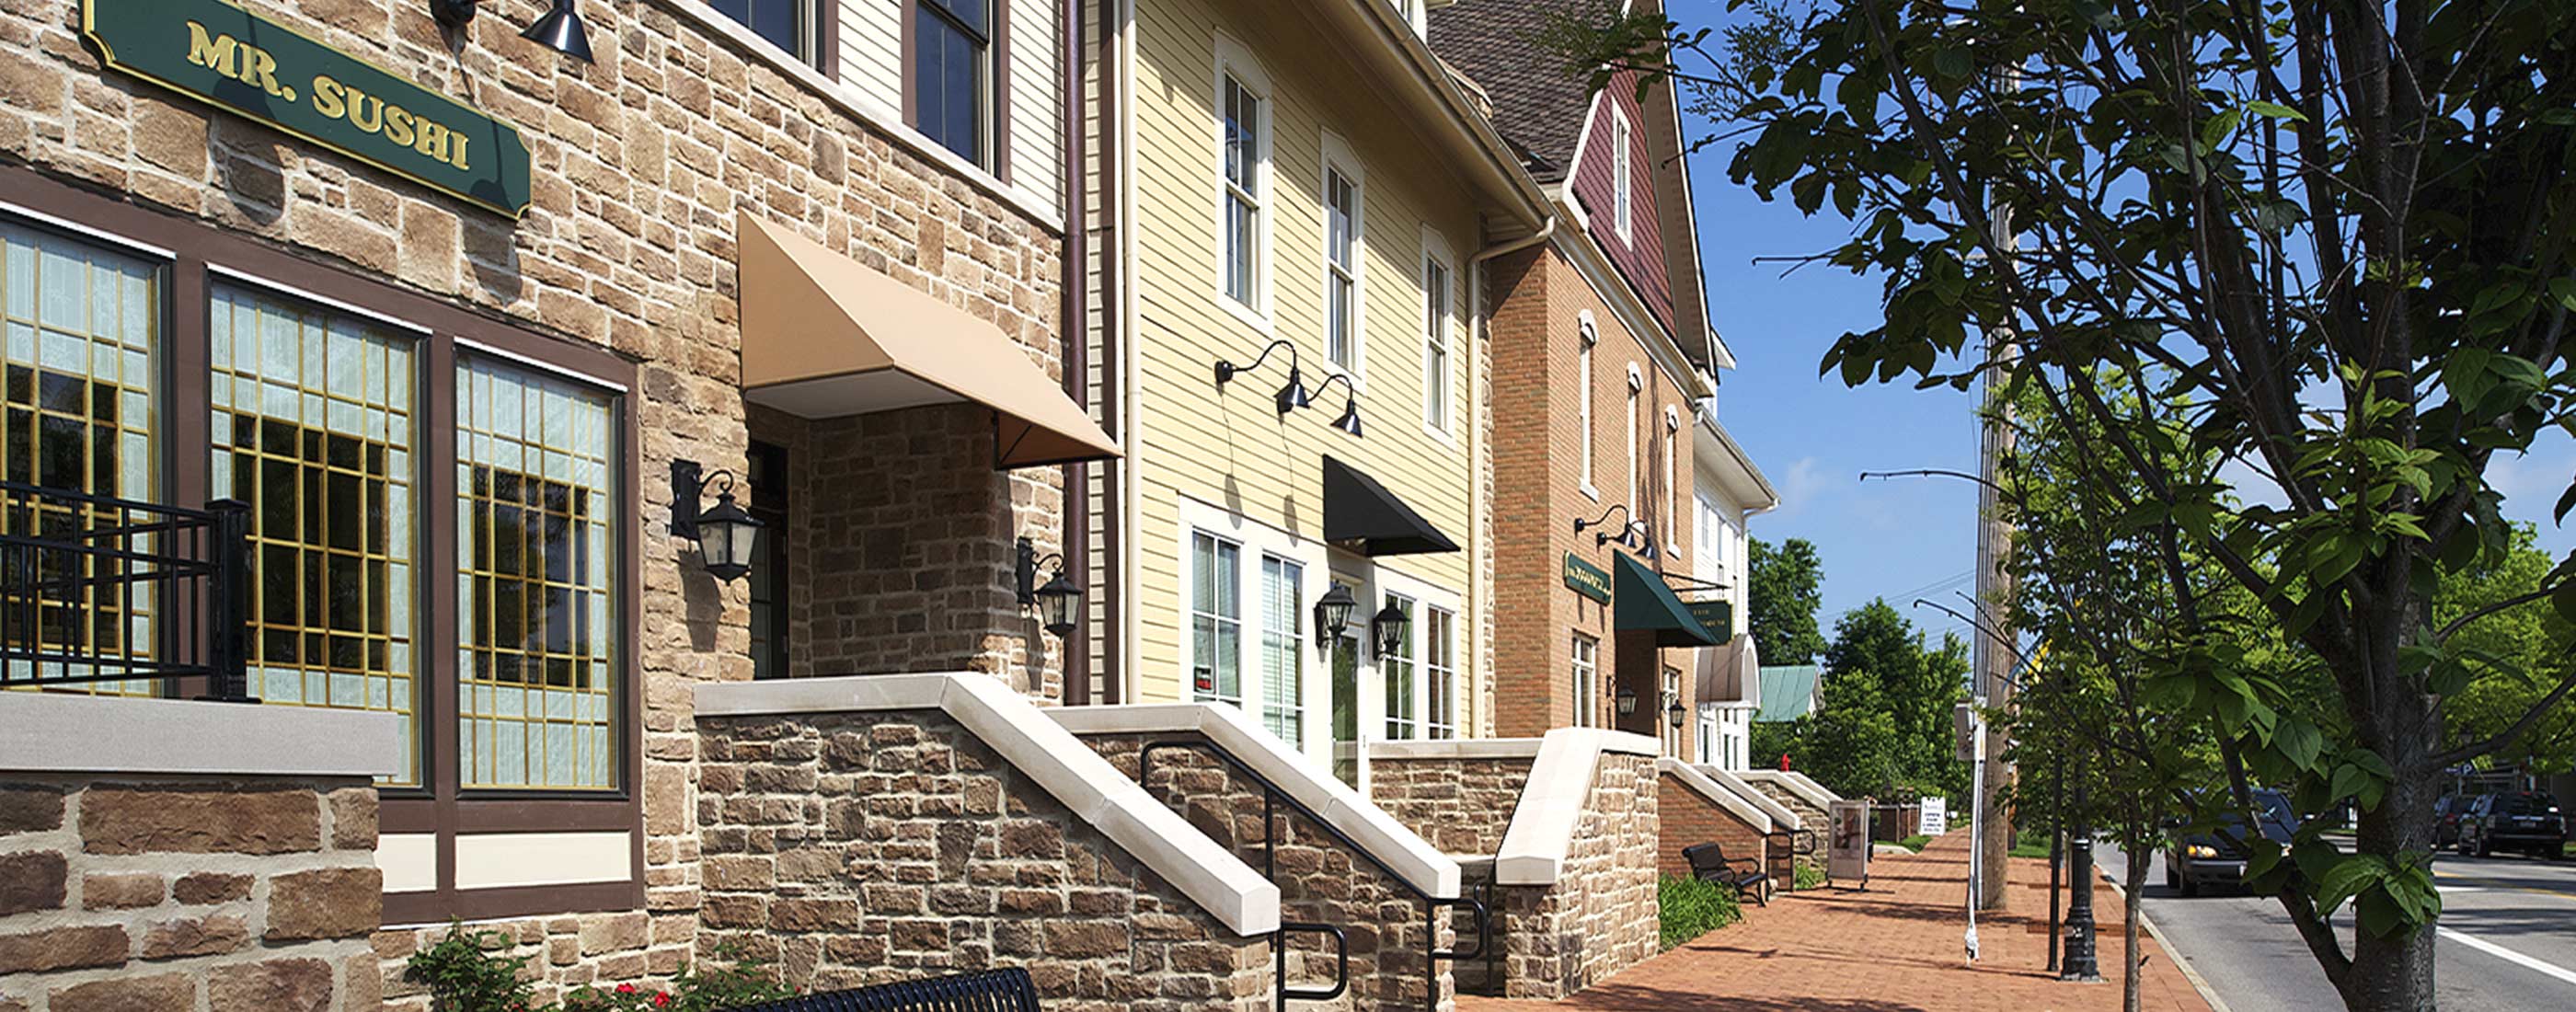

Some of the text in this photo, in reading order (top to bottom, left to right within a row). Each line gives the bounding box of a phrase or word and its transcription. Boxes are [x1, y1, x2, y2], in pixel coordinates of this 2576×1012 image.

[187, 21, 470, 171] MR. SUSHI
[2463, 764, 2473, 776] P
